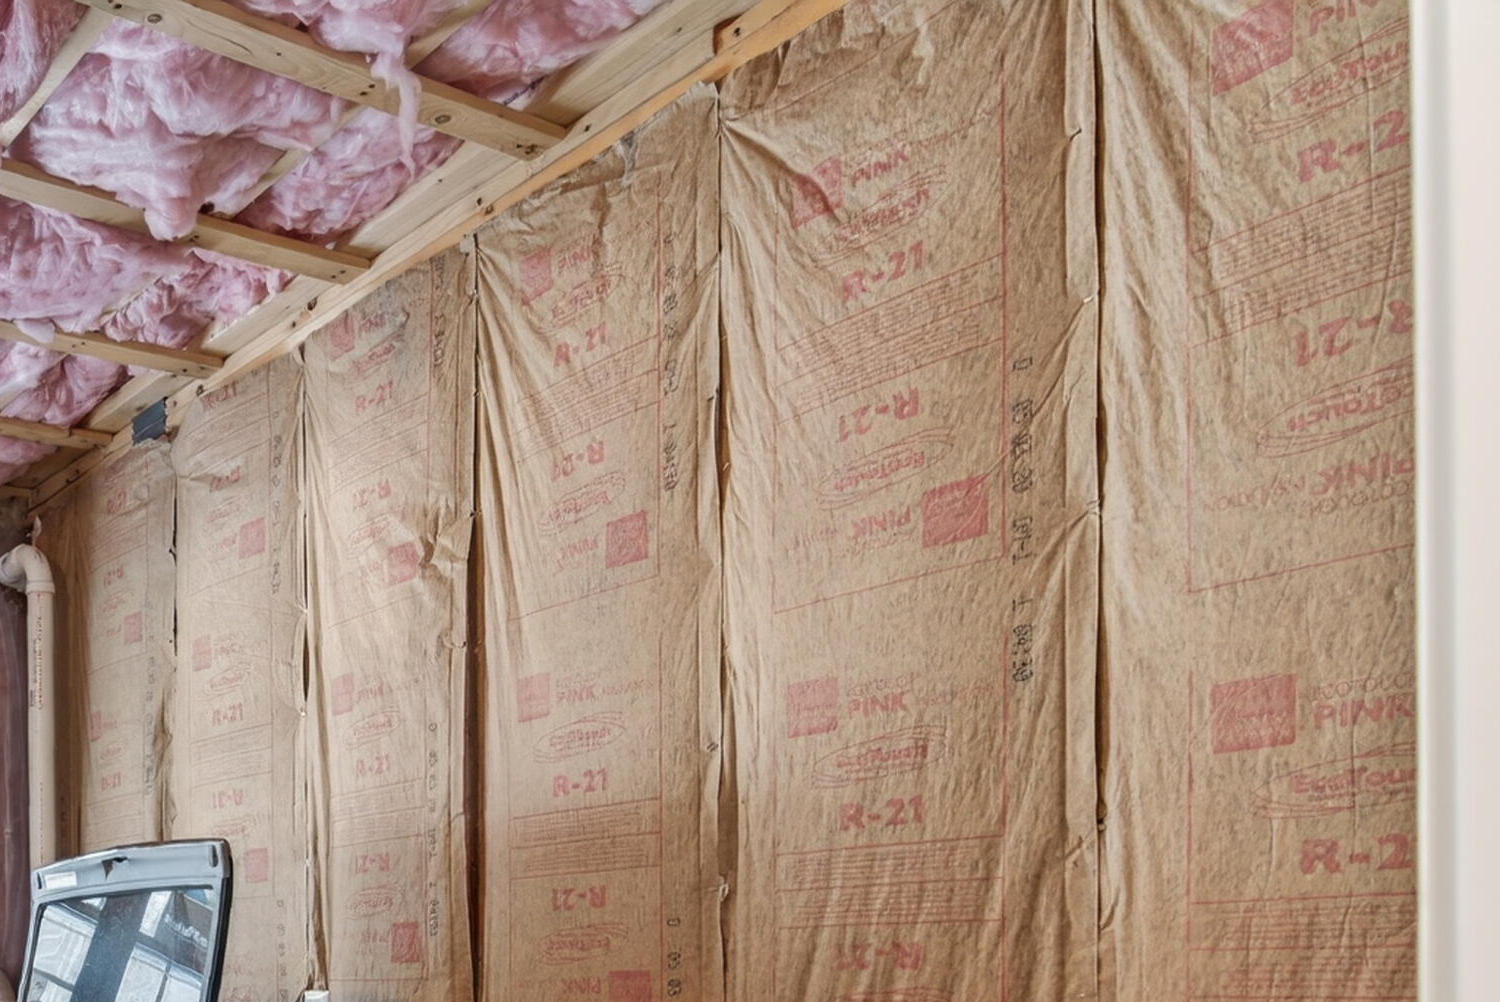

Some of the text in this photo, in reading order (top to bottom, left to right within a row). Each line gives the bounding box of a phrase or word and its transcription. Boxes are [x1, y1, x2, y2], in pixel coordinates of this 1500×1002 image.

[1298, 110, 1409, 184] R-2
[842, 239, 924, 304] R-21
[1295, 300, 1414, 369] R-21
[837, 385, 919, 442] R-21
[852, 503, 910, 542] PINK
[1311, 669, 1415, 700] ECOTOUC
[211, 703, 245, 727] R-21
[849, 693, 908, 720] PINK
[1312, 693, 1415, 731] PINK
[552, 767, 608, 798] R-21
[840, 794, 923, 832] R-21
[1299, 833, 1414, 876] R-2
[552, 885, 606, 911] R-21
